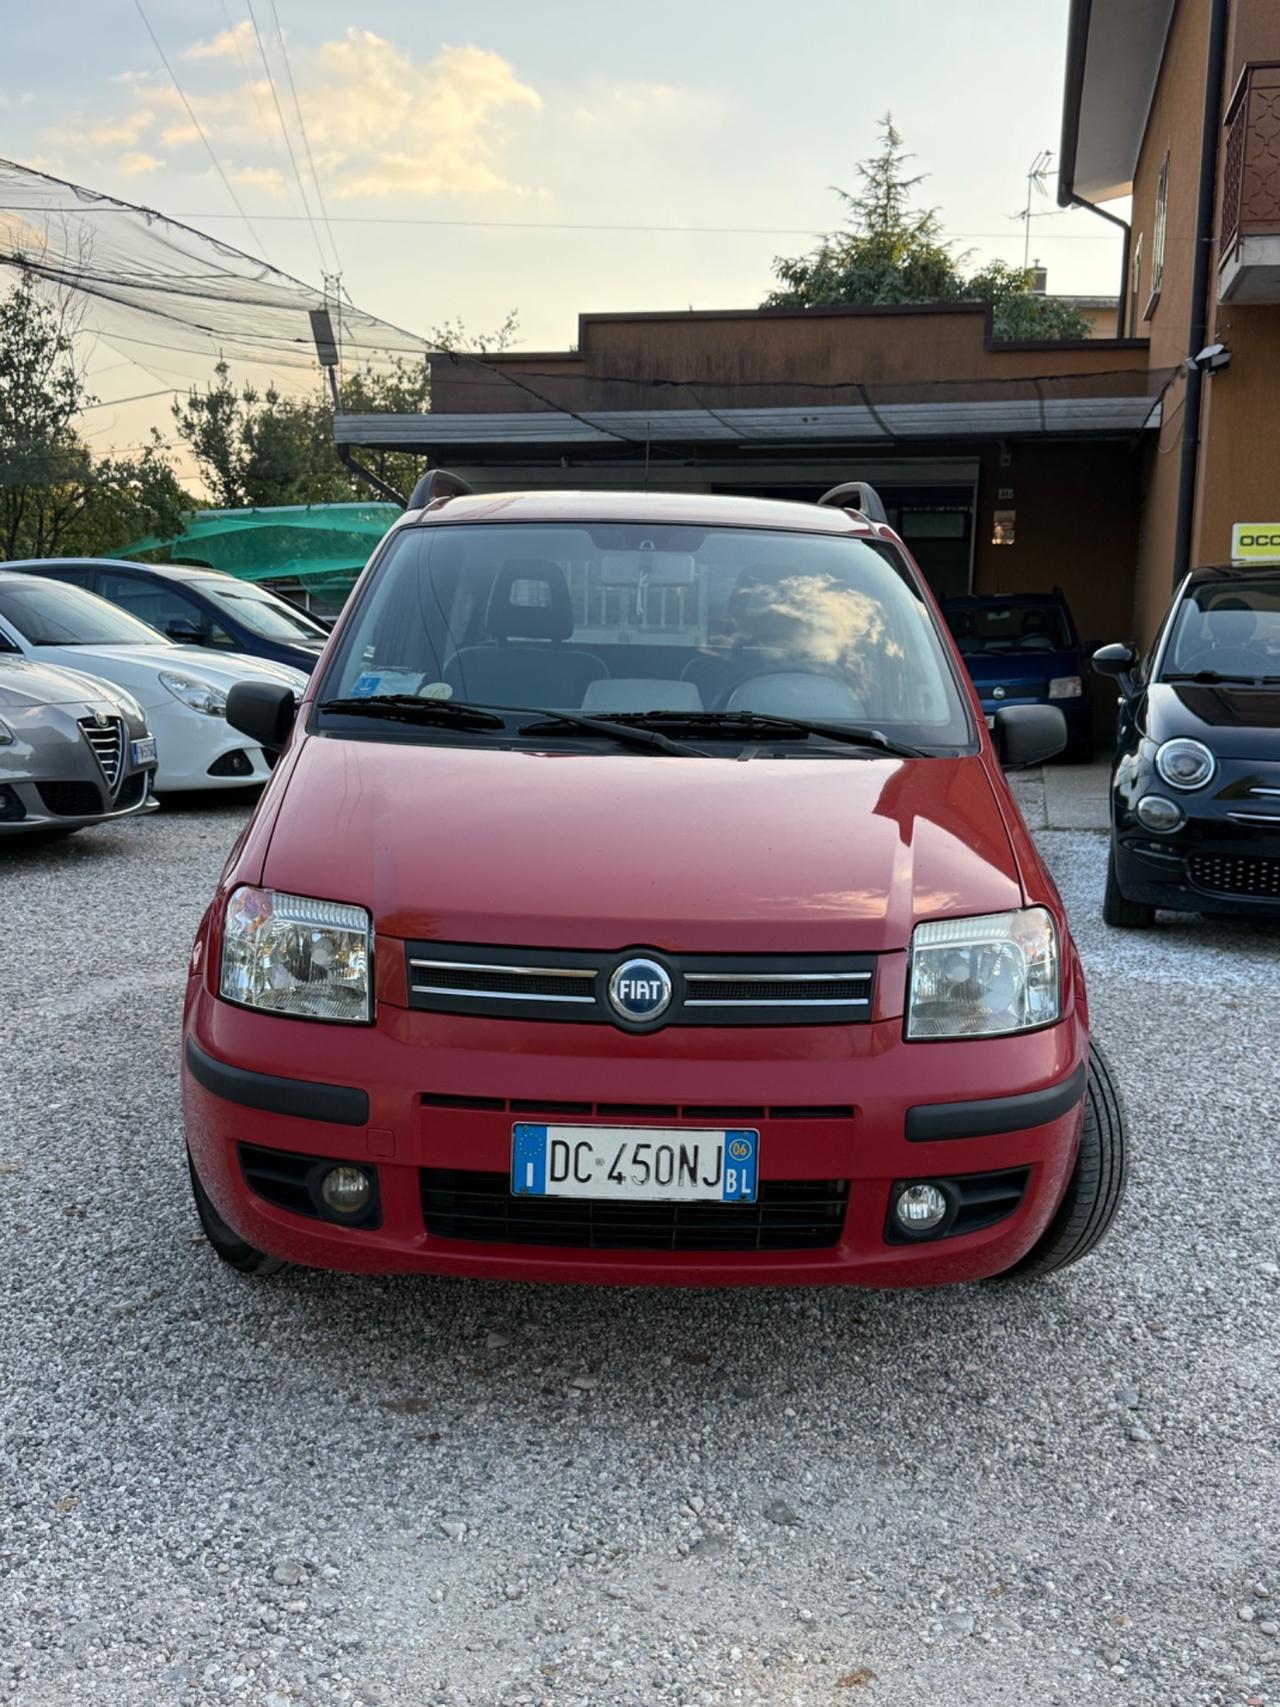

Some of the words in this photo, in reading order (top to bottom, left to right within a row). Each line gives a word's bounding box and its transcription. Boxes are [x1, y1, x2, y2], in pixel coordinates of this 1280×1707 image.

[620, 980, 661, 1000] FIAT
[731, 1143, 748, 1156] 06
[526, 1162, 534, 1187] I
[550, 1140, 594, 1183] DC
[607, 1143, 723, 1187] 450NJ
[725, 1169, 751, 1194] BL
